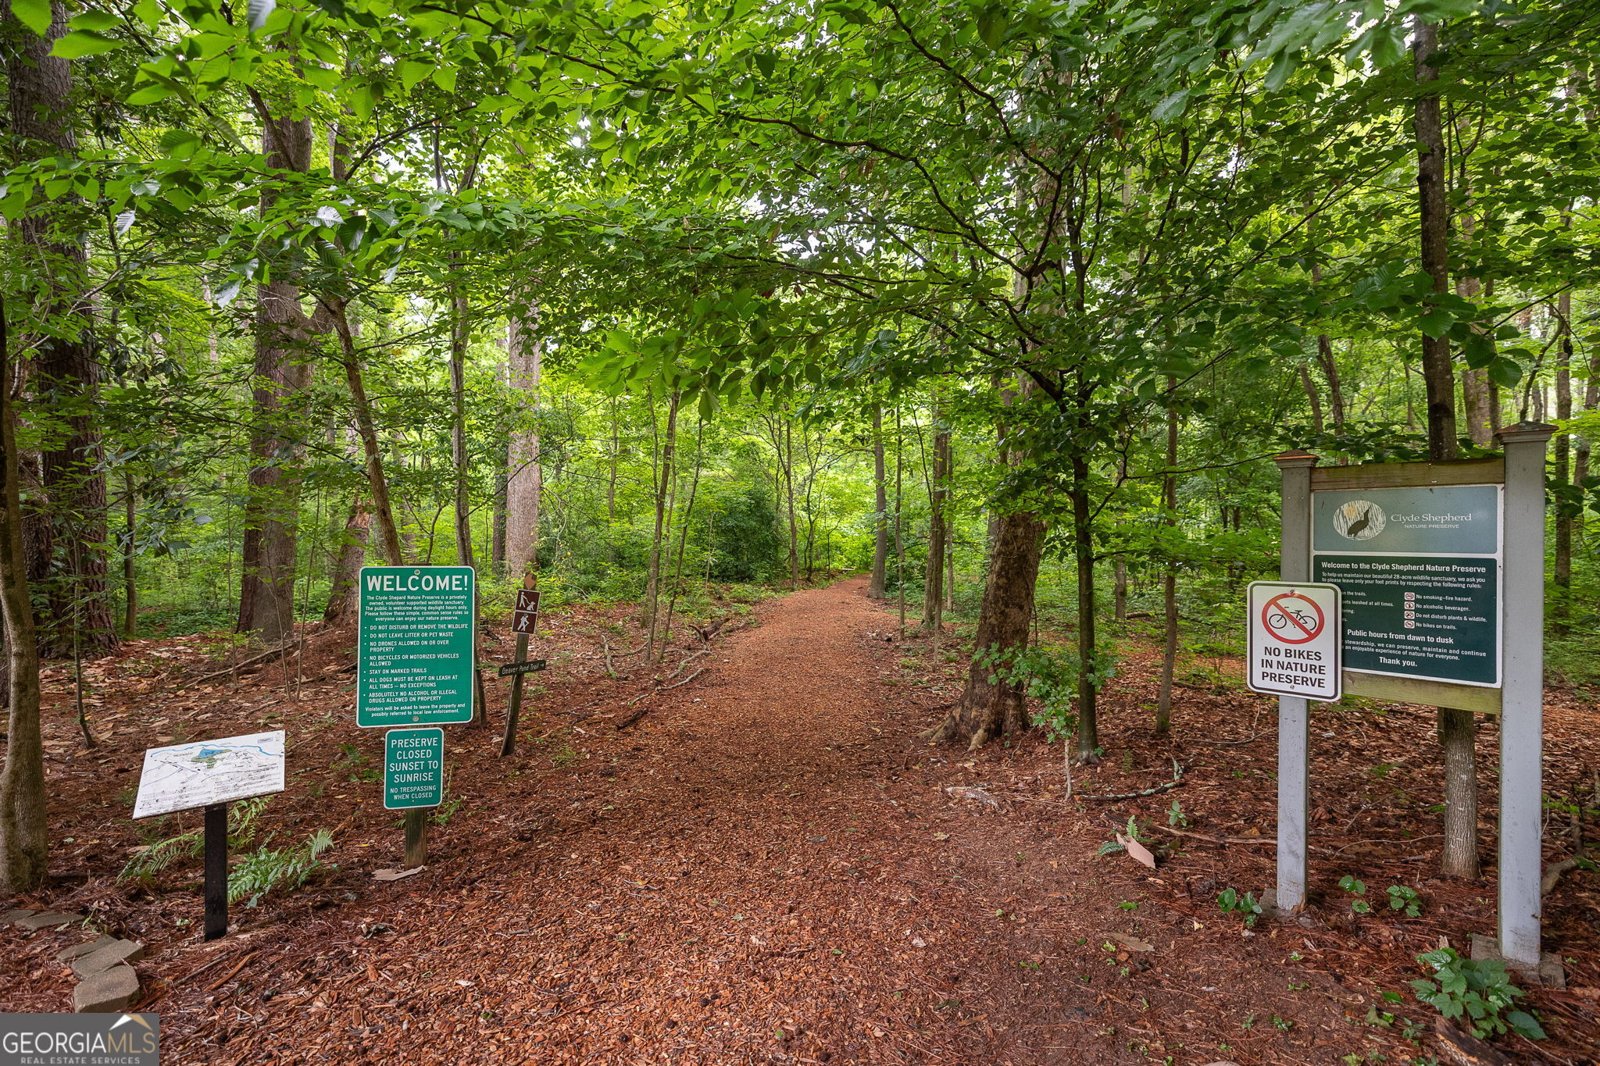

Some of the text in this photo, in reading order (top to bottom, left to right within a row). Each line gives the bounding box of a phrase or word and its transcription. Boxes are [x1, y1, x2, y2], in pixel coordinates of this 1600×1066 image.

[1391, 513, 1472, 524] Clyde Shepherd
[1372, 563, 1390, 571] Clyde
[1391, 563, 1424, 571] Shepherd
[1426, 564, 1450, 572] Nature
[1452, 565, 1486, 573] Preserve
[367, 575, 468, 591] WELCOME!
[1389, 632, 1405, 640] from
[1407, 634, 1425, 642] dawn
[1436, 636, 1454, 644] dusk
[1264, 646, 1322, 661] NO BIKES
[1379, 656, 1401, 665] Thank
[1261, 659, 1326, 675] IN NATURE
[1262, 672, 1325, 688] PRESERVE
[391, 738, 438, 748] PRESERVE
[396, 749, 432, 759] CLOSED
[389, 761, 438, 772] SUNSET TO
[394, 772, 433, 783] SUNRISE
[400, 785, 436, 793] TRESPASSING
